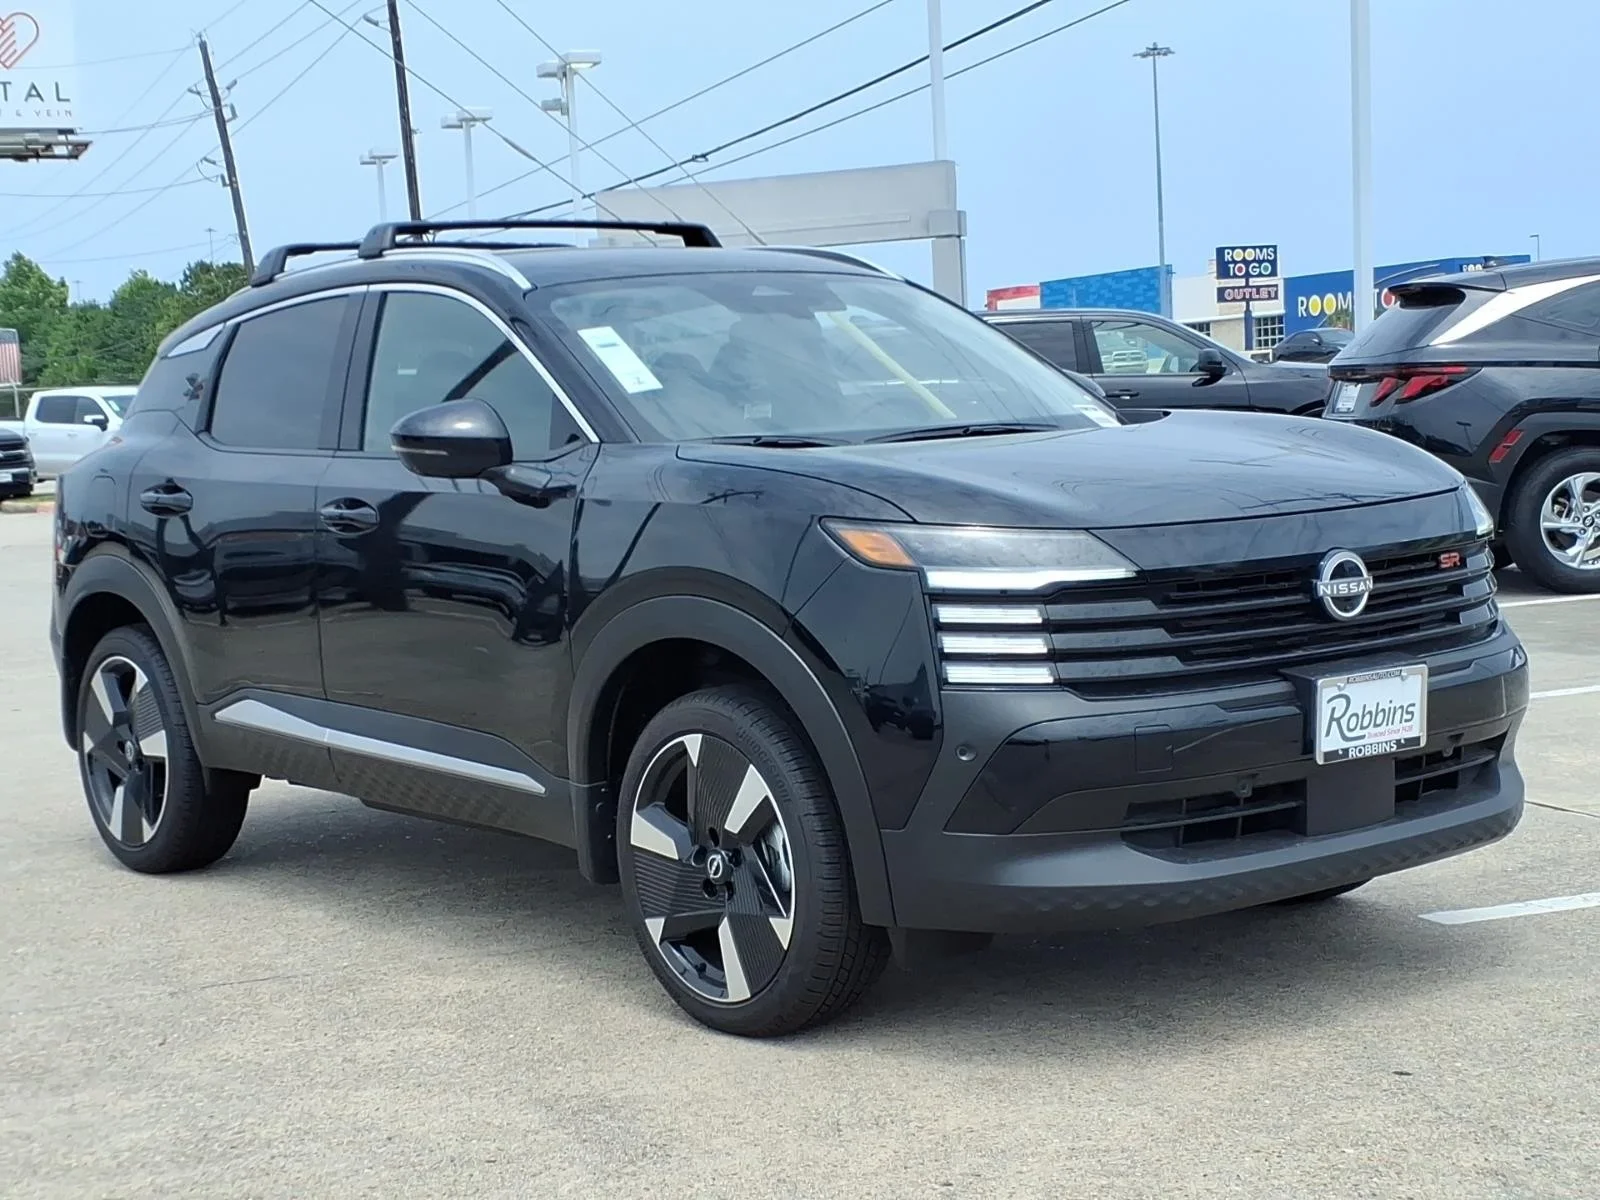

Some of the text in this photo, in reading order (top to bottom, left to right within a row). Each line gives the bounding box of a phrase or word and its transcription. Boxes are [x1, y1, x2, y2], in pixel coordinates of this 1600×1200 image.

[35, 109, 72, 117] VEIN
[1224, 247, 1275, 261] ROOMS
[1228, 262, 1272, 276] TO GO
[1224, 287, 1277, 300] OUTLET
[1297, 290, 1353, 317] ROOM
[1439, 552, 1461, 568] SR
[1319, 578, 1373, 596] NISSAN
[1324, 693, 1416, 742] Robbins
[1348, 740, 1397, 758] ROBBINS
